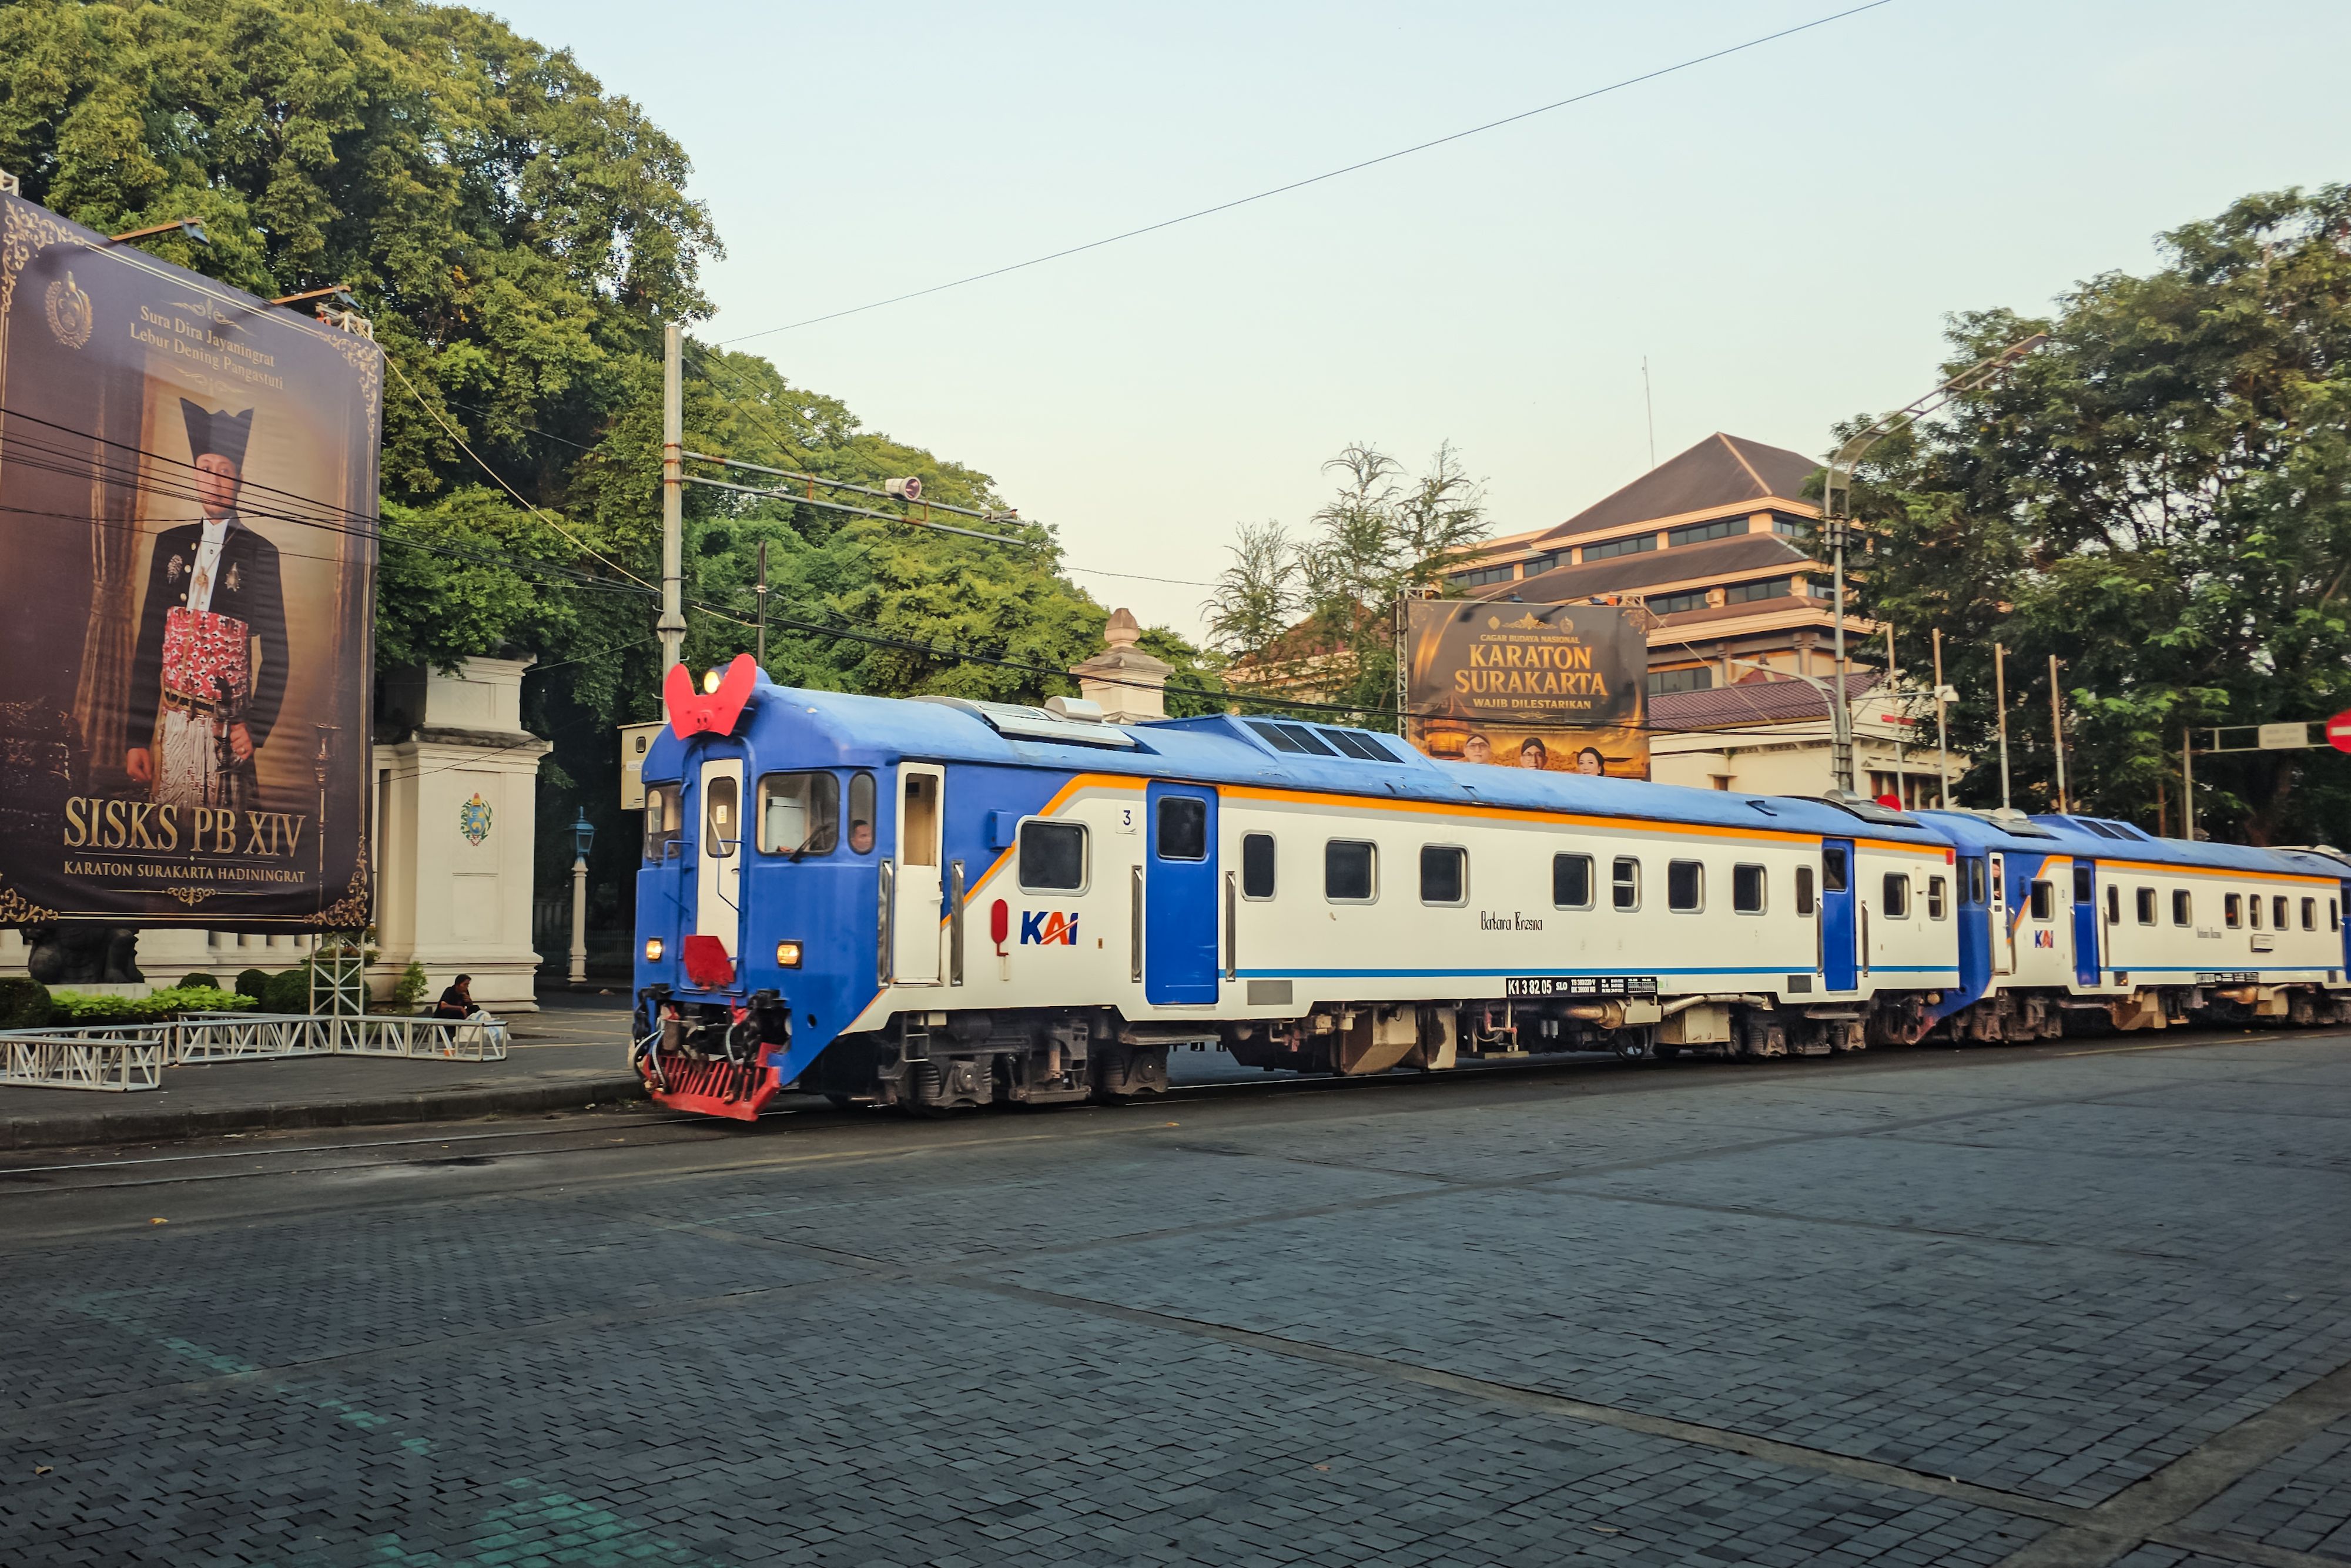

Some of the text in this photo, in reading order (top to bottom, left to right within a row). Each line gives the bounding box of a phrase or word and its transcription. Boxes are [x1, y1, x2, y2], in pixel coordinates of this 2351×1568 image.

[140, 306, 276, 367] Sura Dira Jayaningrat
[130, 323, 284, 390] Lebur Dening Pangastuti
[1541, 636, 1580, 644] NASIONAL
[1469, 644, 1593, 670] KARATON
[1454, 669, 1609, 696] SURAKARTA
[1473, 698, 1591, 709] WAJIB DILESTARIKAN
[63, 796, 306, 857] SISKS PB XIV
[1123, 809, 1131, 826] 3
[63, 861, 306, 883] KARATON SURAKARTA HADININGRAT
[1020, 911, 1079, 946] KAI
[1481, 910, 1542, 931] Batara Kresna
[2034, 930, 2054, 949] KAI
[1522, 979, 1528, 994] 3
[1529, 979, 1540, 994] 82
[1541, 979, 1552, 994] 05
[1556, 981, 1568, 991] SLO
